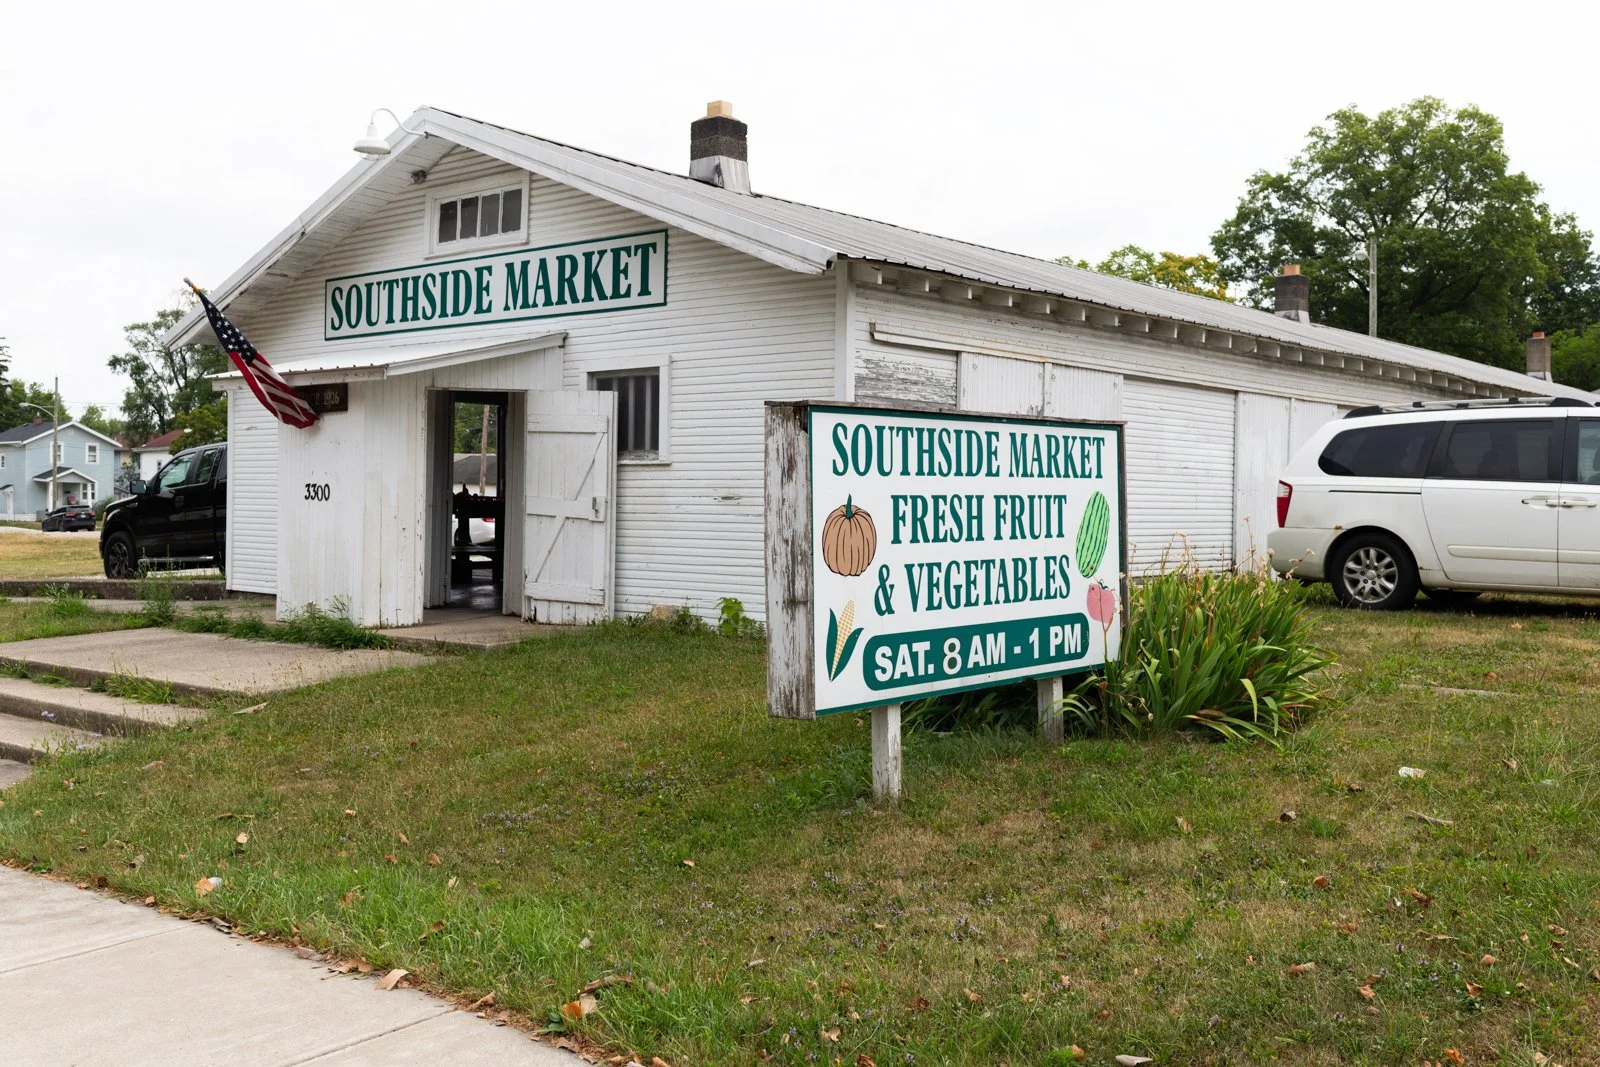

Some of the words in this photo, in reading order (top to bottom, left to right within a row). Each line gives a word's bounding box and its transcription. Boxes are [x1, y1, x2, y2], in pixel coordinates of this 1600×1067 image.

[330, 265, 493, 331] SOUTHSIDE
[503, 242, 657, 312] MARKET
[323, 391, 340, 405] 1926
[832, 422, 1000, 477] SOUTHSIDE
[1008, 432, 1105, 479] MARKET
[304, 483, 331, 501] 3300
[890, 494, 985, 545] FRESH
[993, 494, 1067, 541] FRUIT
[874, 564, 895, 617] &
[904, 554, 1071, 613] VEGETABLES
[874, 641, 935, 682] SAT.
[942, 637, 963, 675] 8
[967, 632, 1006, 669] AM
[1014, 645, 1021, 654] -
[1028, 627, 1040, 659] 1
[1050, 623, 1082, 657] PM
